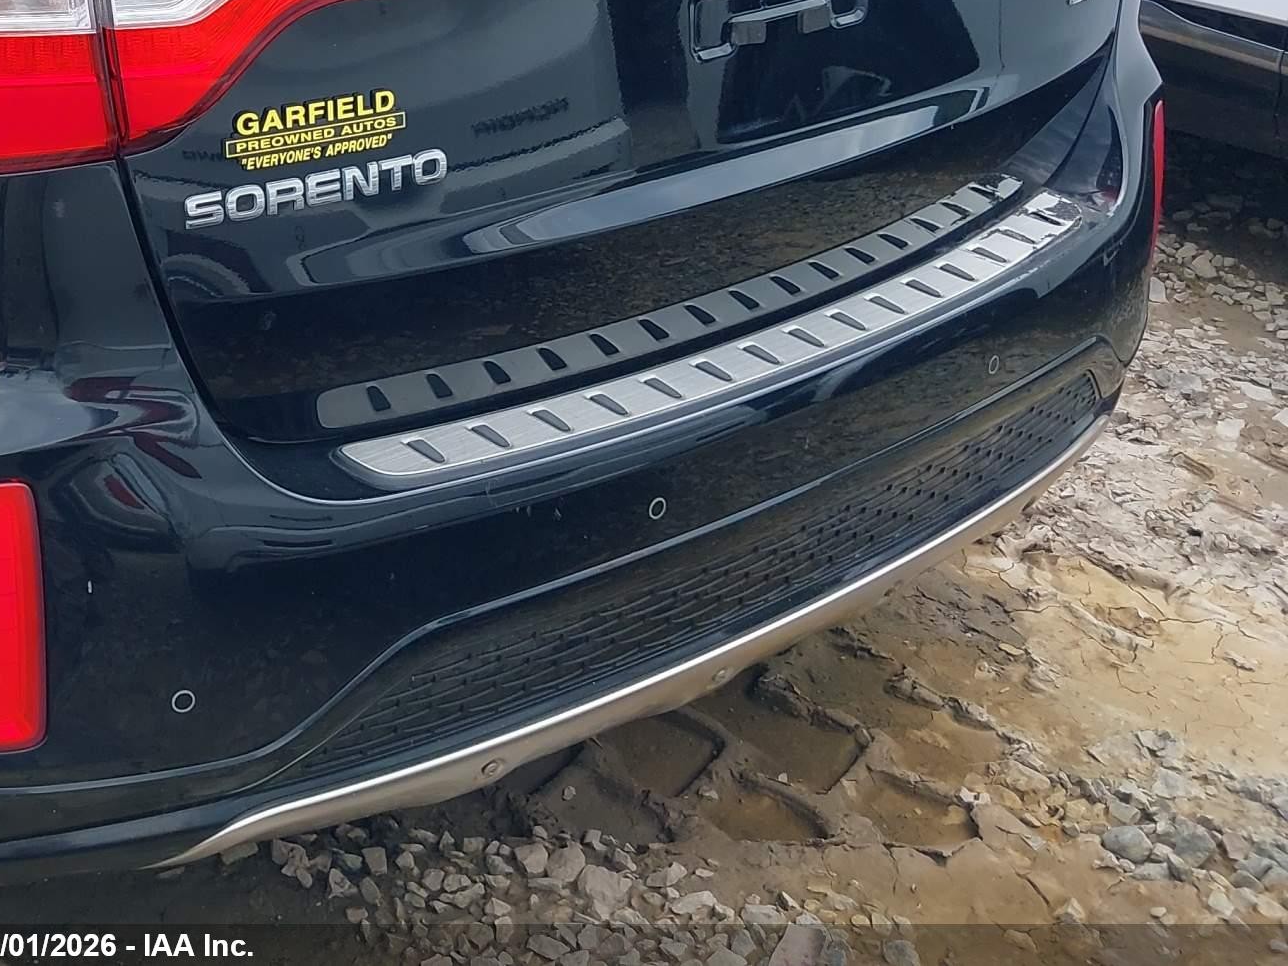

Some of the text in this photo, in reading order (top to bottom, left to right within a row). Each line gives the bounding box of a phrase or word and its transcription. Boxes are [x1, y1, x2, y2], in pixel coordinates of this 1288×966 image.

[235, 89, 396, 136] GARFIELD
[235, 116, 397, 153] PREOWNED AUTOS
[241, 145, 322, 171] "EVERYONE'S
[324, 133, 392, 158] APPROVED"
[184, 148, 449, 230] SORENTO
